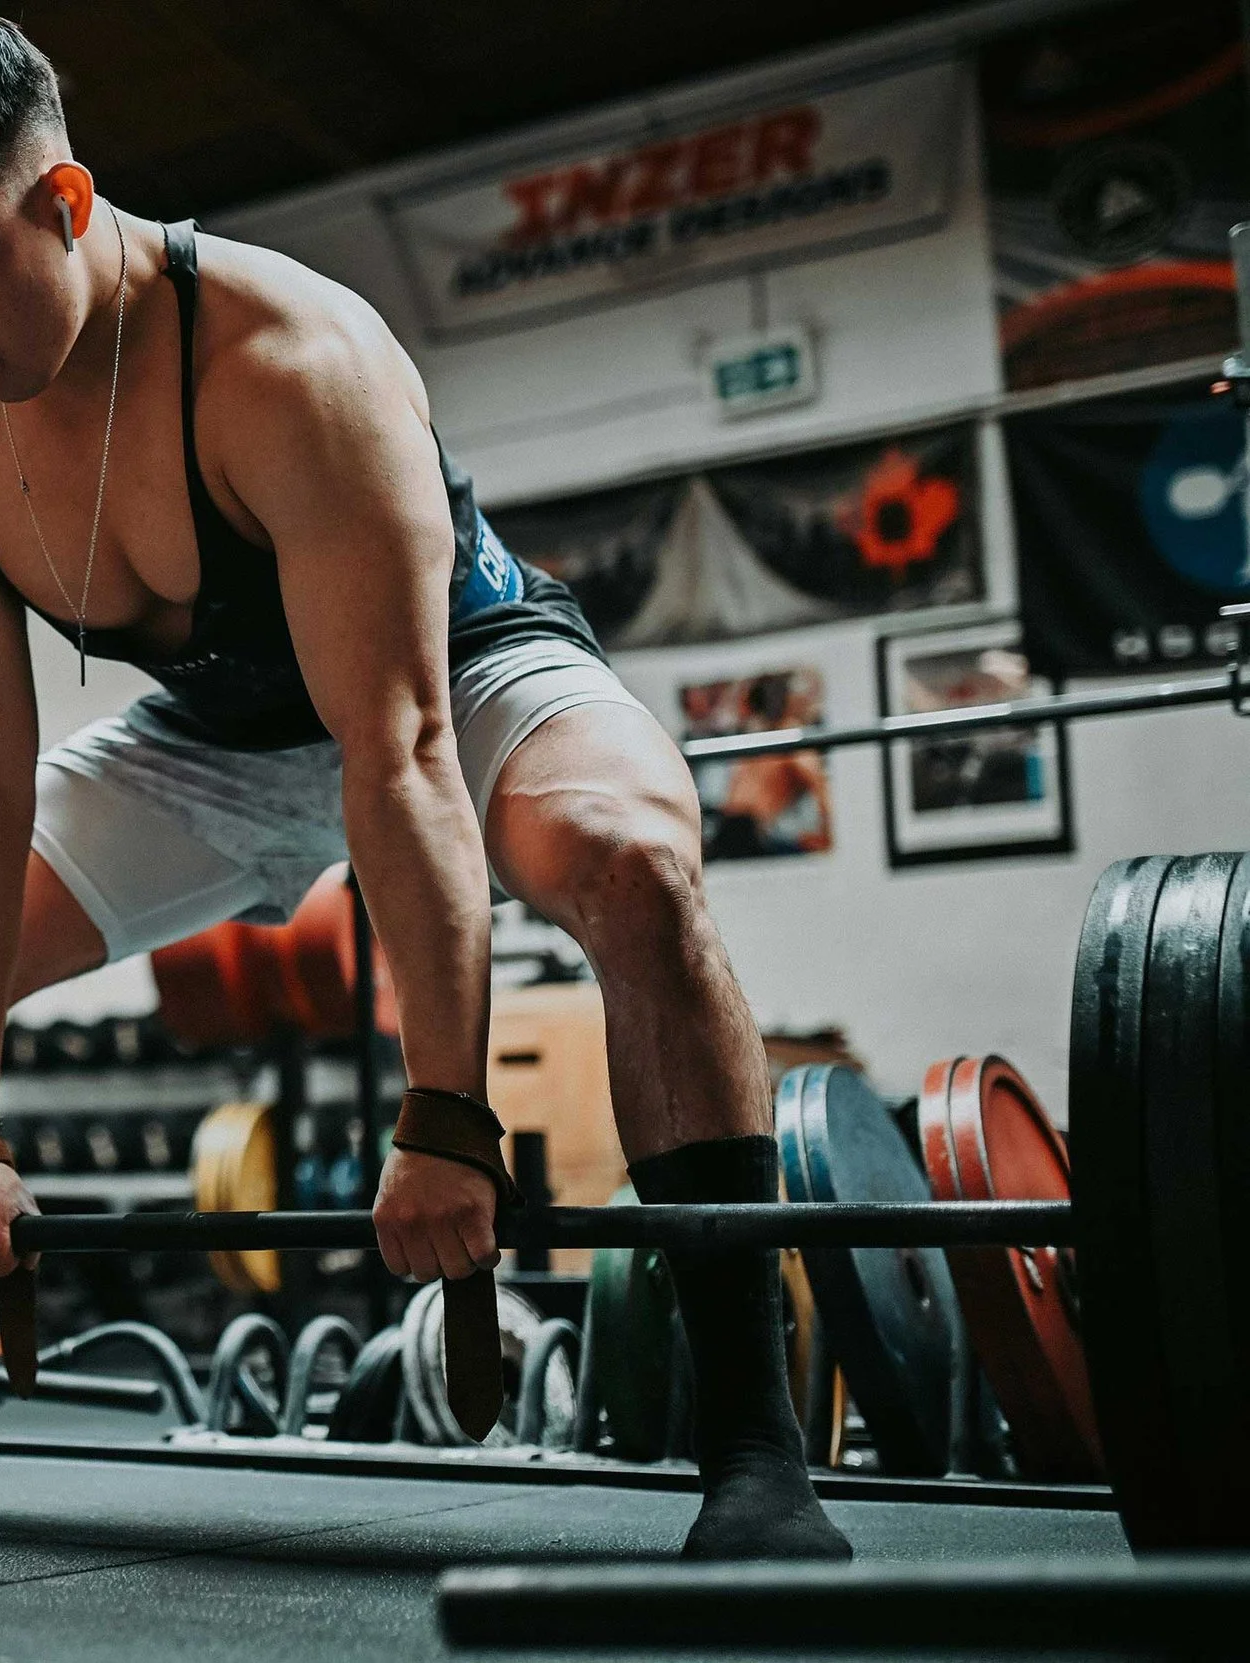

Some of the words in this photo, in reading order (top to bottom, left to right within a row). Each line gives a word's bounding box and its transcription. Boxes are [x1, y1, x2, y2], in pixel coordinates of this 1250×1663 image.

[455, 217, 656, 294] ADVANCE
[670, 157, 892, 240] DESIGNS
[501, 103, 822, 247] INZER
